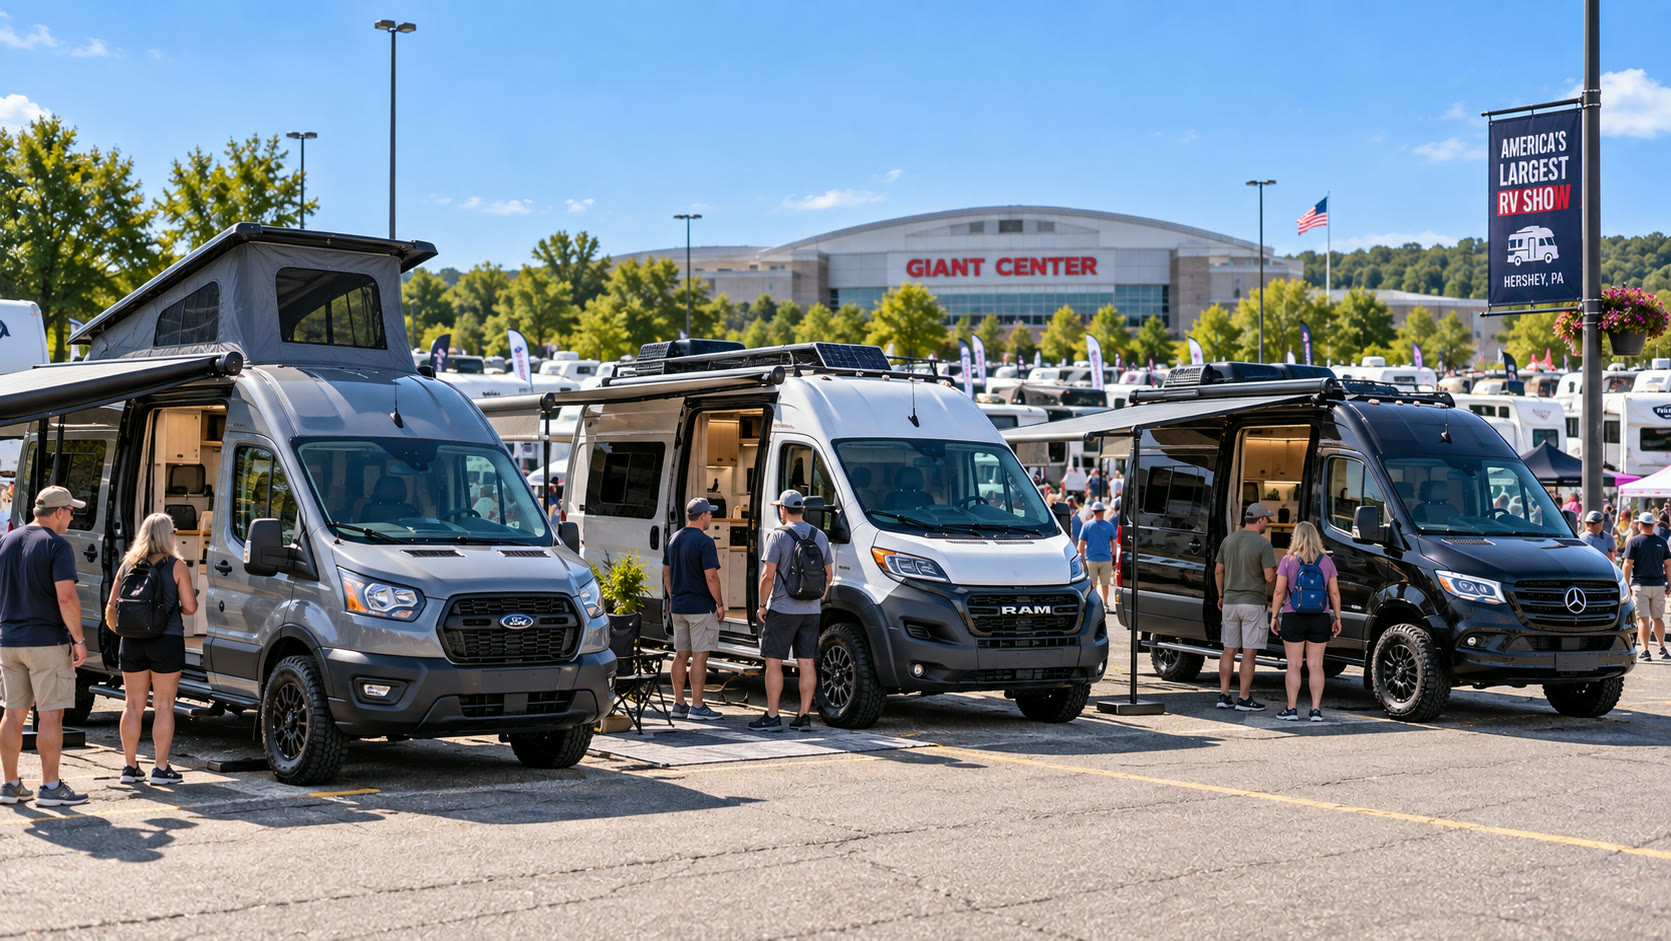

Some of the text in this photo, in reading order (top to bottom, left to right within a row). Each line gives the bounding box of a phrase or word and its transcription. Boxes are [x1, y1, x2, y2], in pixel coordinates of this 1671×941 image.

[1501, 130, 1567, 159] AMERICA'S
[1499, 155, 1570, 187] LARGEST
[1499, 183, 1572, 215] RV SHOW
[906, 256, 1098, 278] GIANT CENTER
[1503, 271, 1565, 288] HERSHEY, PA
[1001, 605, 1051, 615] RAM
